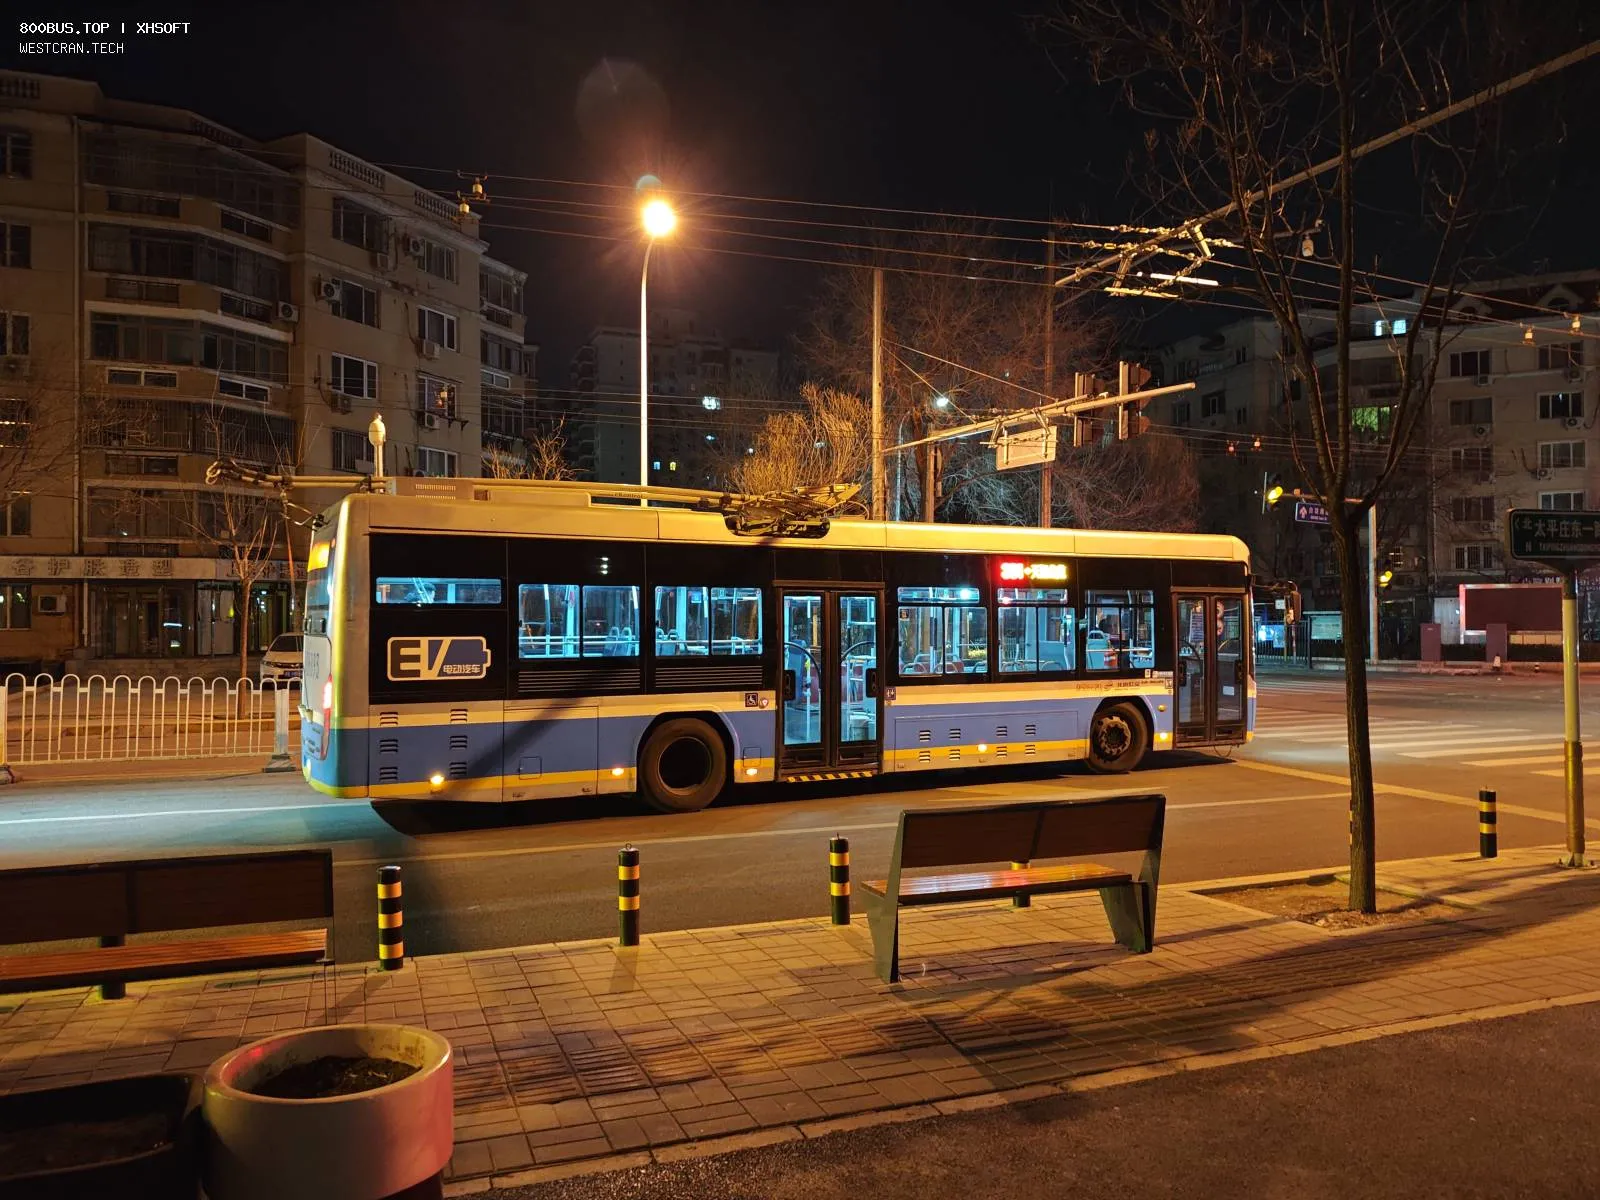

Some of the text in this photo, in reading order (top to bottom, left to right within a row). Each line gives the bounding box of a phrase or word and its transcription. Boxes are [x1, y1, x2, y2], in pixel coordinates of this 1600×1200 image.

[391, 638, 453, 680] EV
[443, 664, 481, 675] 电动汽车
